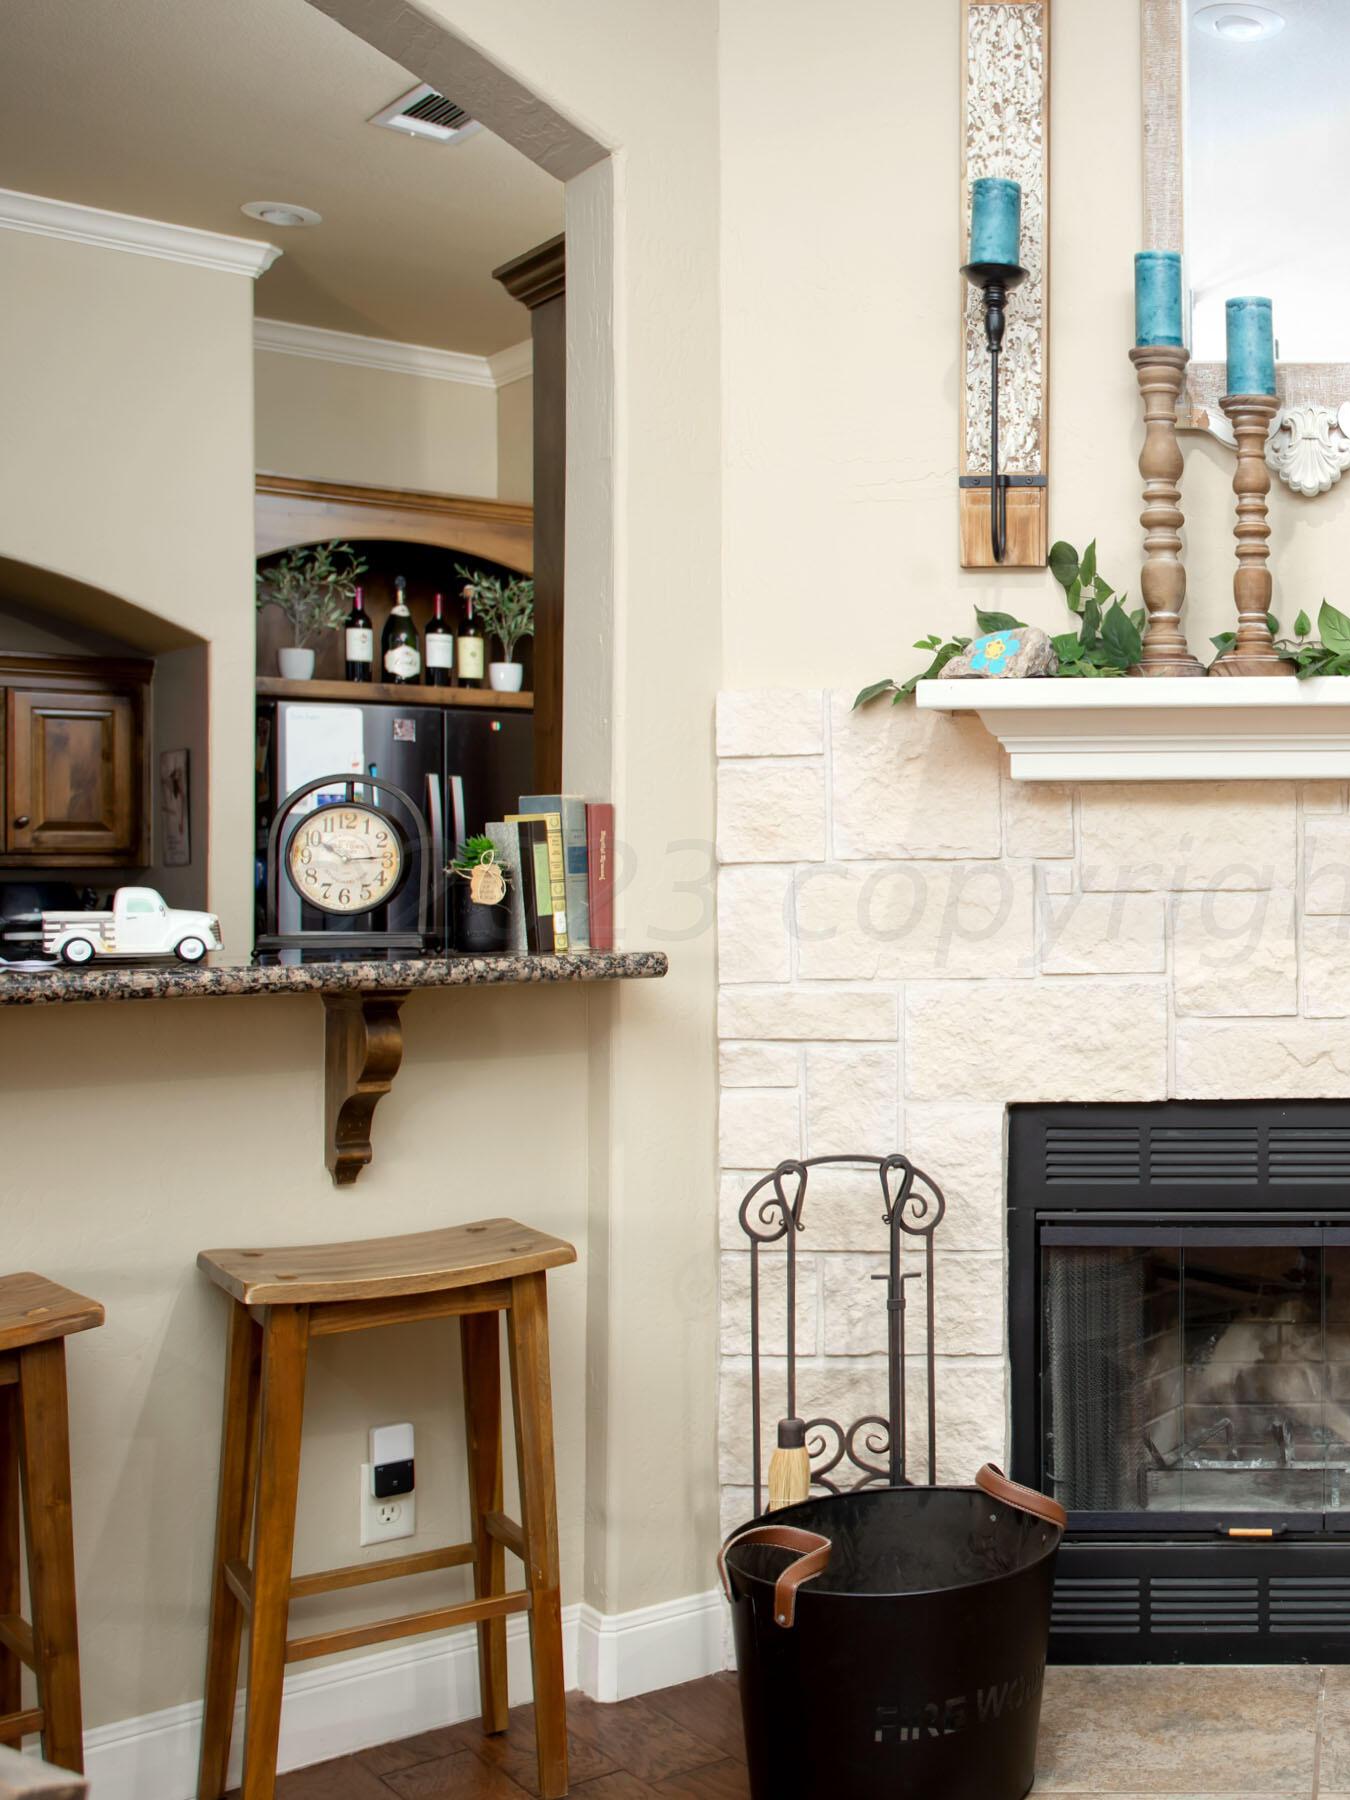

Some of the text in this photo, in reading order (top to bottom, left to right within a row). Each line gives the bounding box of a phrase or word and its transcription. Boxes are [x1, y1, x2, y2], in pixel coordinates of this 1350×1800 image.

[322, 816, 335, 833] 11
[338, 812, 358, 830] 12
[361, 818, 371, 835] 1
[305, 829, 322, 848] 10
[376, 831, 389, 848] 2
[300, 848, 313, 865] 9
[381, 851, 394, 869] 3
[305, 867, 318, 885] 8
[374, 870, 388, 887] 4
[321, 882, 333, 900] 7
[338, 888, 351, 905] 6
[360, 884, 372, 901] 5
